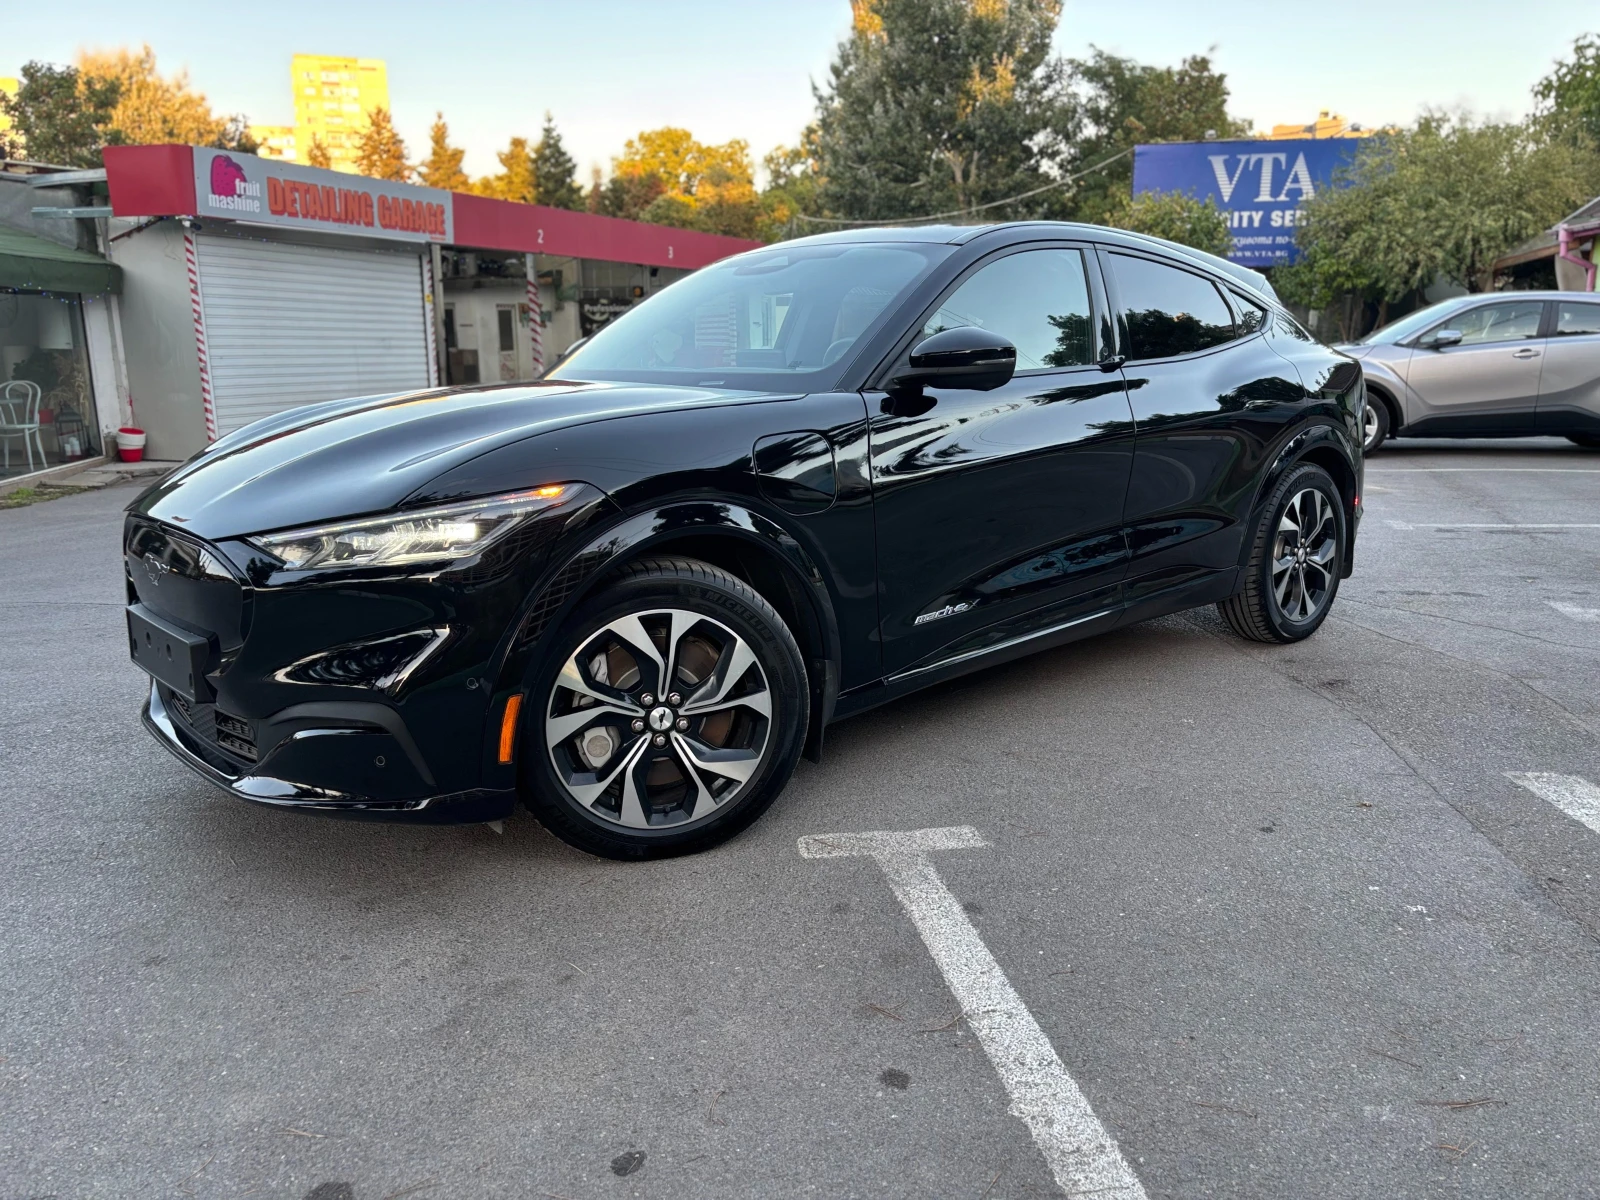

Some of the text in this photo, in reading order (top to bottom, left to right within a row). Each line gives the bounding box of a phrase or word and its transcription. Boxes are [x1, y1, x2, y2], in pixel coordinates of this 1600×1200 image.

[1207, 151, 1316, 203] VTA
[235, 178, 261, 198] fruit
[208, 193, 260, 214] mashine
[266, 175, 446, 236] DETAILING GARAGE
[537, 228, 544, 244] 2
[668, 245, 674, 260] 3
